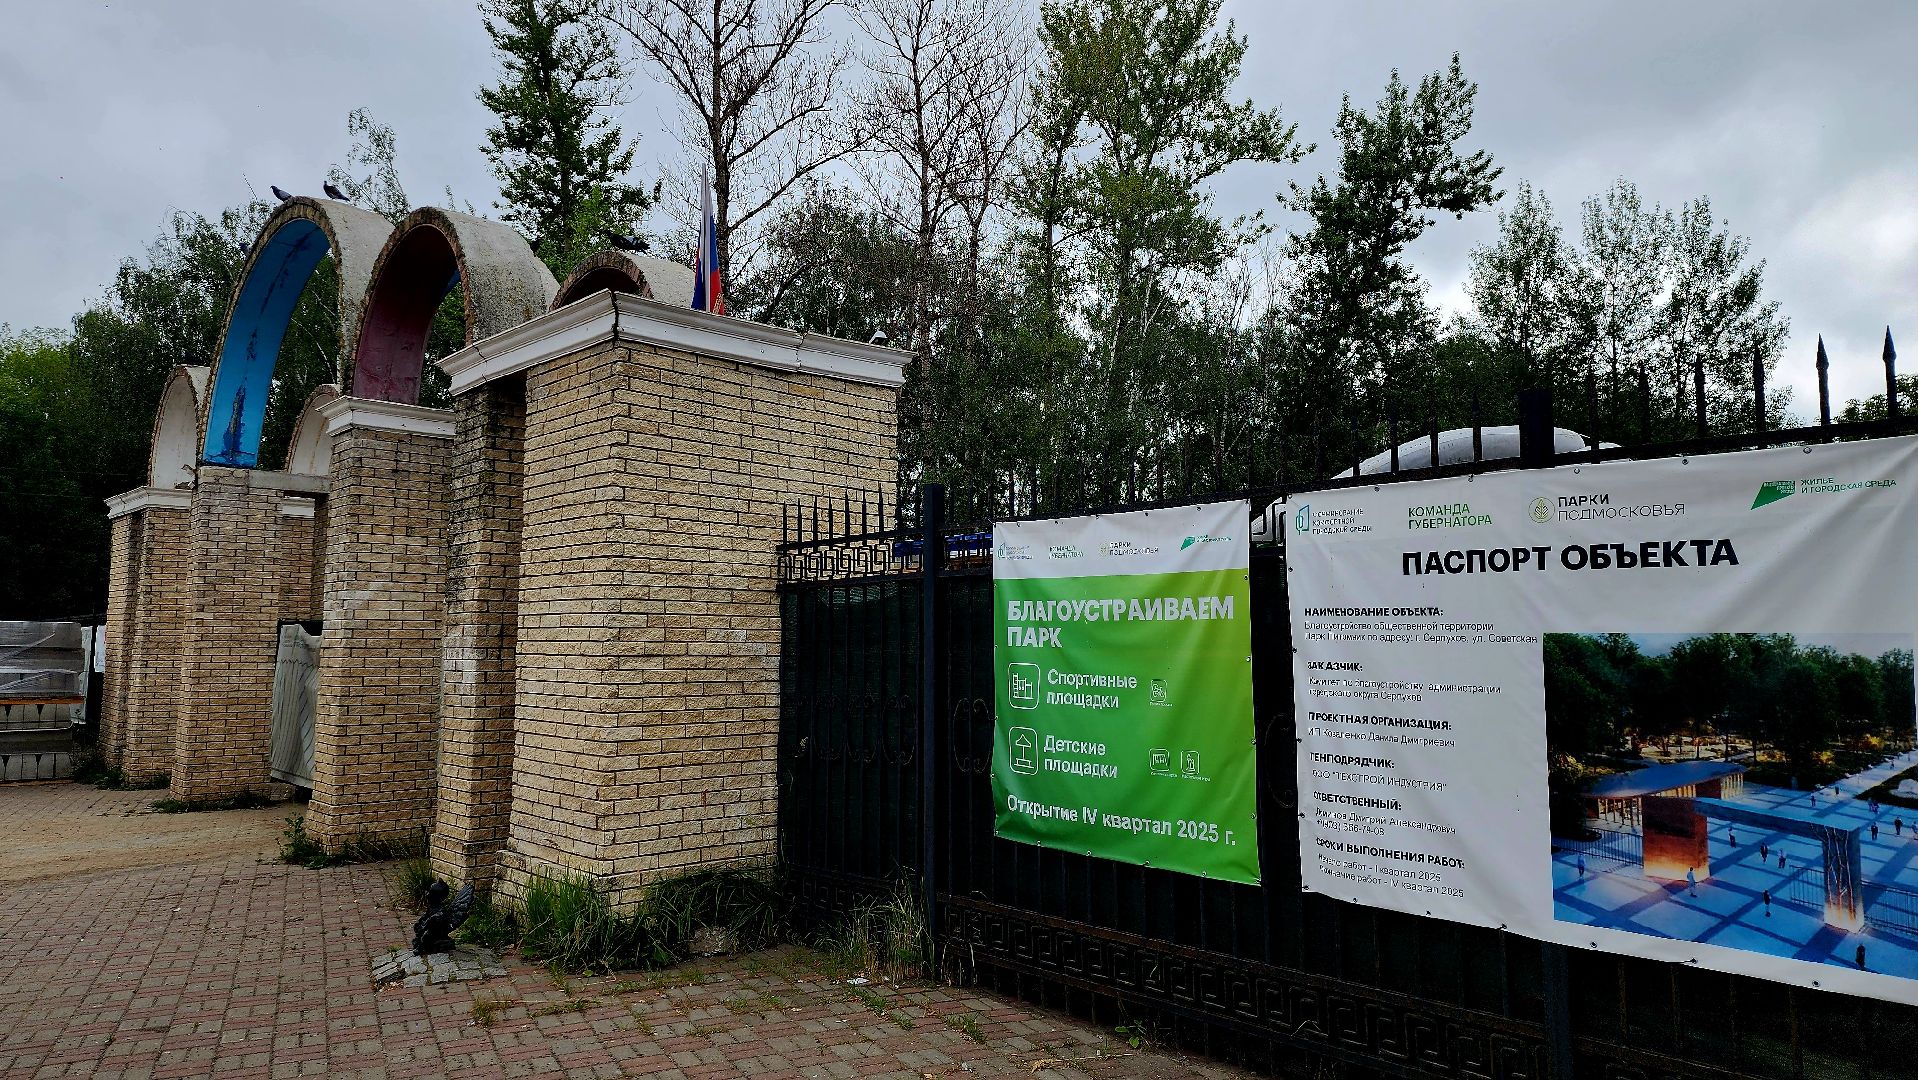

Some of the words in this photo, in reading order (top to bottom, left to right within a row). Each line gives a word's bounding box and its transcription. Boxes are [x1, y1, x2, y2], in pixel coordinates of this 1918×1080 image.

[1810, 481, 1863, 493] ГОРОДСКАЯ
[1865, 479, 1897, 488] СРЕДА
[1558, 494, 1610, 507] ПАРКИ
[1408, 503, 1470, 518] КОМАНДА
[1557, 503, 1686, 522] ПОДМОСКОВЬЯ
[1408, 515, 1493, 530] ГУБЕРНАТОРА
[1402, 545, 1552, 576] ПАСПОРТ
[1560, 538, 1740, 571] ОБЪЕКТА
[1007, 595, 1234, 622] БЛАГОУСТРАИВАЕМ
[1304, 607, 1390, 617] НАИМЕНОВАНИЕ
[1391, 607, 1444, 617] ОБЪЕКТА:
[1374, 621, 1438, 632] общественной
[1439, 623, 1494, 632] территории
[1007, 626, 1063, 648] ПАРК
[1488, 633, 1538, 643] Советская
[1047, 668, 1137, 690] Спортивные
[1428, 683, 1501, 695] администрации
[1046, 690, 1119, 710] площадки
[1308, 711, 1369, 725] ПРОЕКТНАЯ
[1370, 715, 1452, 731] ОРГАНИЗАЦИЯ:
[1043, 734, 1106, 756] Детские
[1367, 731, 1399, 743] Данила
[1044, 758, 1118, 779] площадки
[1309, 752, 1395, 769] ГЕНПОДРЯДЧИК:
[1313, 790, 1402, 811] ОТВЕТСТВЕННЫЙ:
[1007, 794, 1078, 822] Открытие
[1082, 806, 1097, 825] IV
[1102, 811, 1172, 836] квартал
[1176, 819, 1219, 843] 2025
[1225, 828, 1236, 846] г.
[1315, 837, 1344, 852] СРОКИ
[1346, 843, 1425, 863] ВЫПОЛНЕНИЯ
[1427, 854, 1466, 869] РАБОТ:
[1418, 870, 1442, 882] 2025
